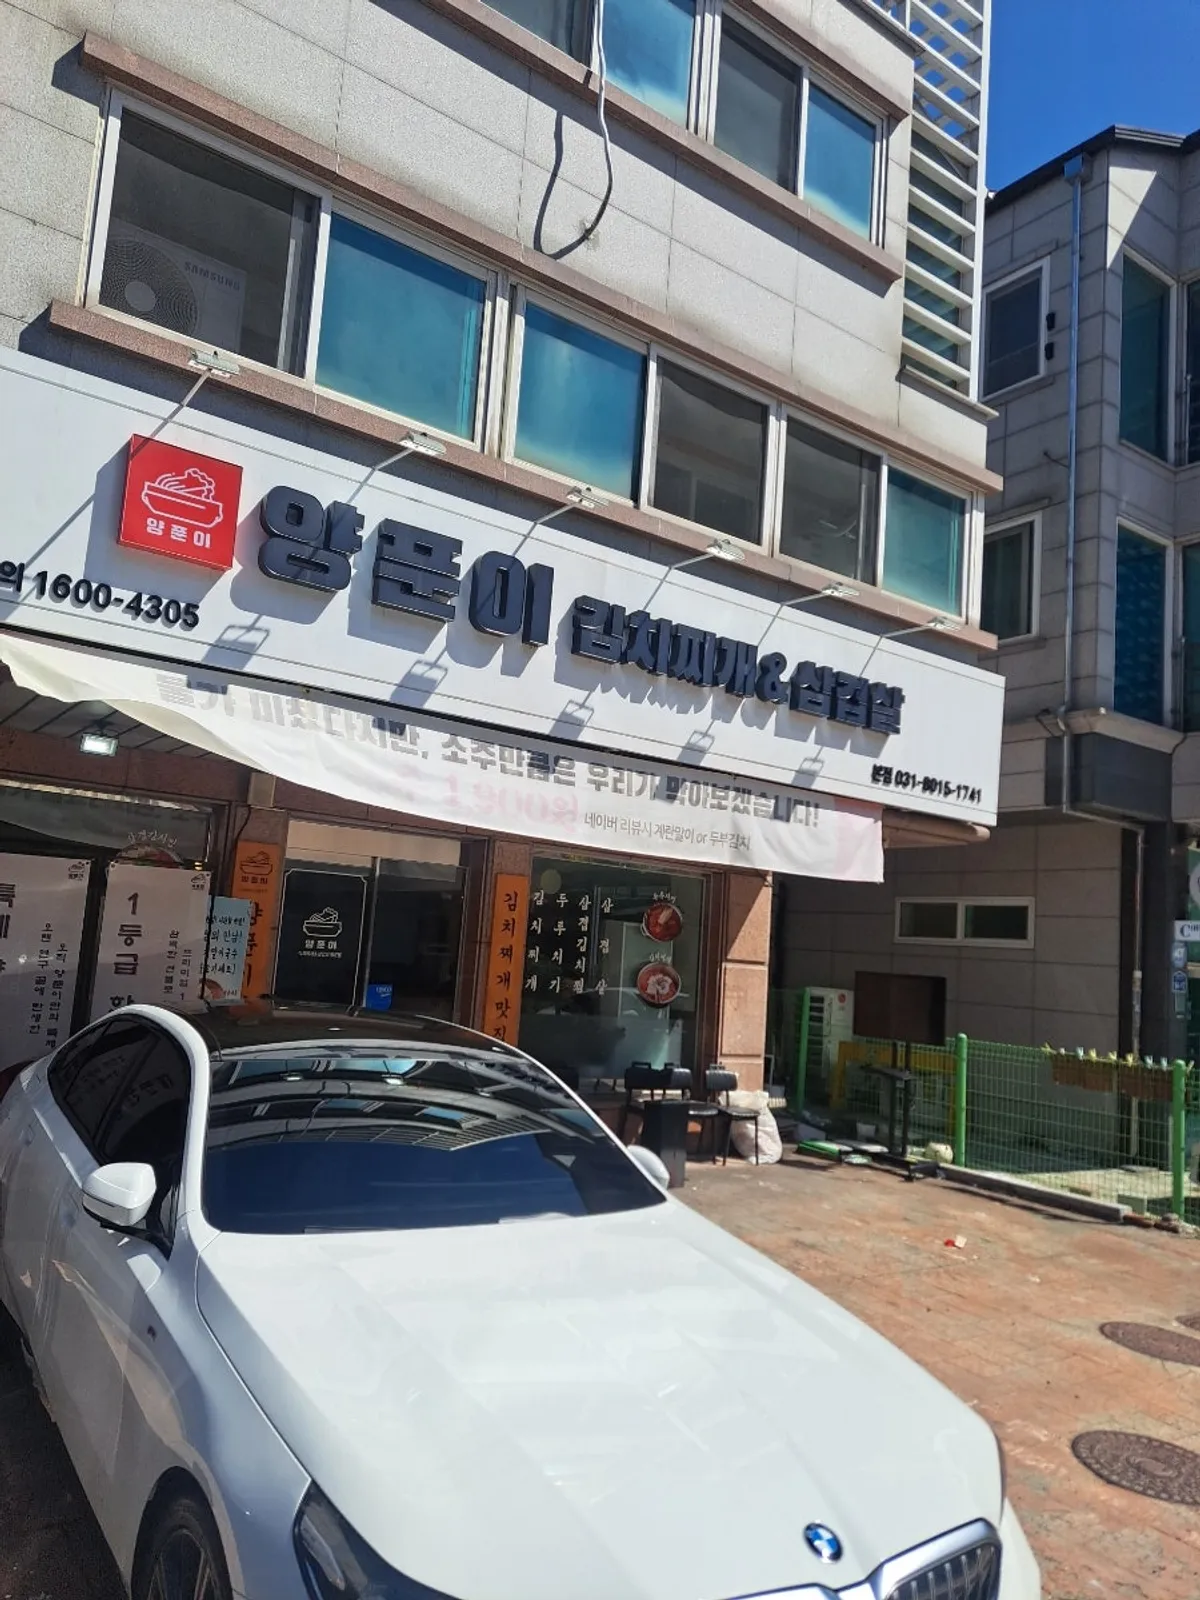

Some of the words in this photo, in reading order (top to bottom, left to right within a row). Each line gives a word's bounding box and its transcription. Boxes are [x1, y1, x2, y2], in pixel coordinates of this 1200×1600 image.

[183, 261, 241, 292] SAMSUNG
[145, 517, 212, 549] 양푼이
[35, 570, 200, 628] 1600-4305
[258, 484, 555, 648] 양푼이
[570, 594, 906, 735] 김치찌개&삼겹살
[441, 733, 577, 788] 소주만큼은
[587, 762, 655, 801] 우리가
[871, 763, 894, 785] 본점
[584, 812, 618, 832] 네이버
[620, 818, 652, 837] 리뷰시
[654, 823, 695, 843] 계란말이
[696, 833, 708, 844] or
[709, 830, 751, 851] 두부김치
[114, 891, 142, 975] 1등급
[525, 889, 545, 992] 김치찌개
[549, 893, 568, 993] 두루치기
